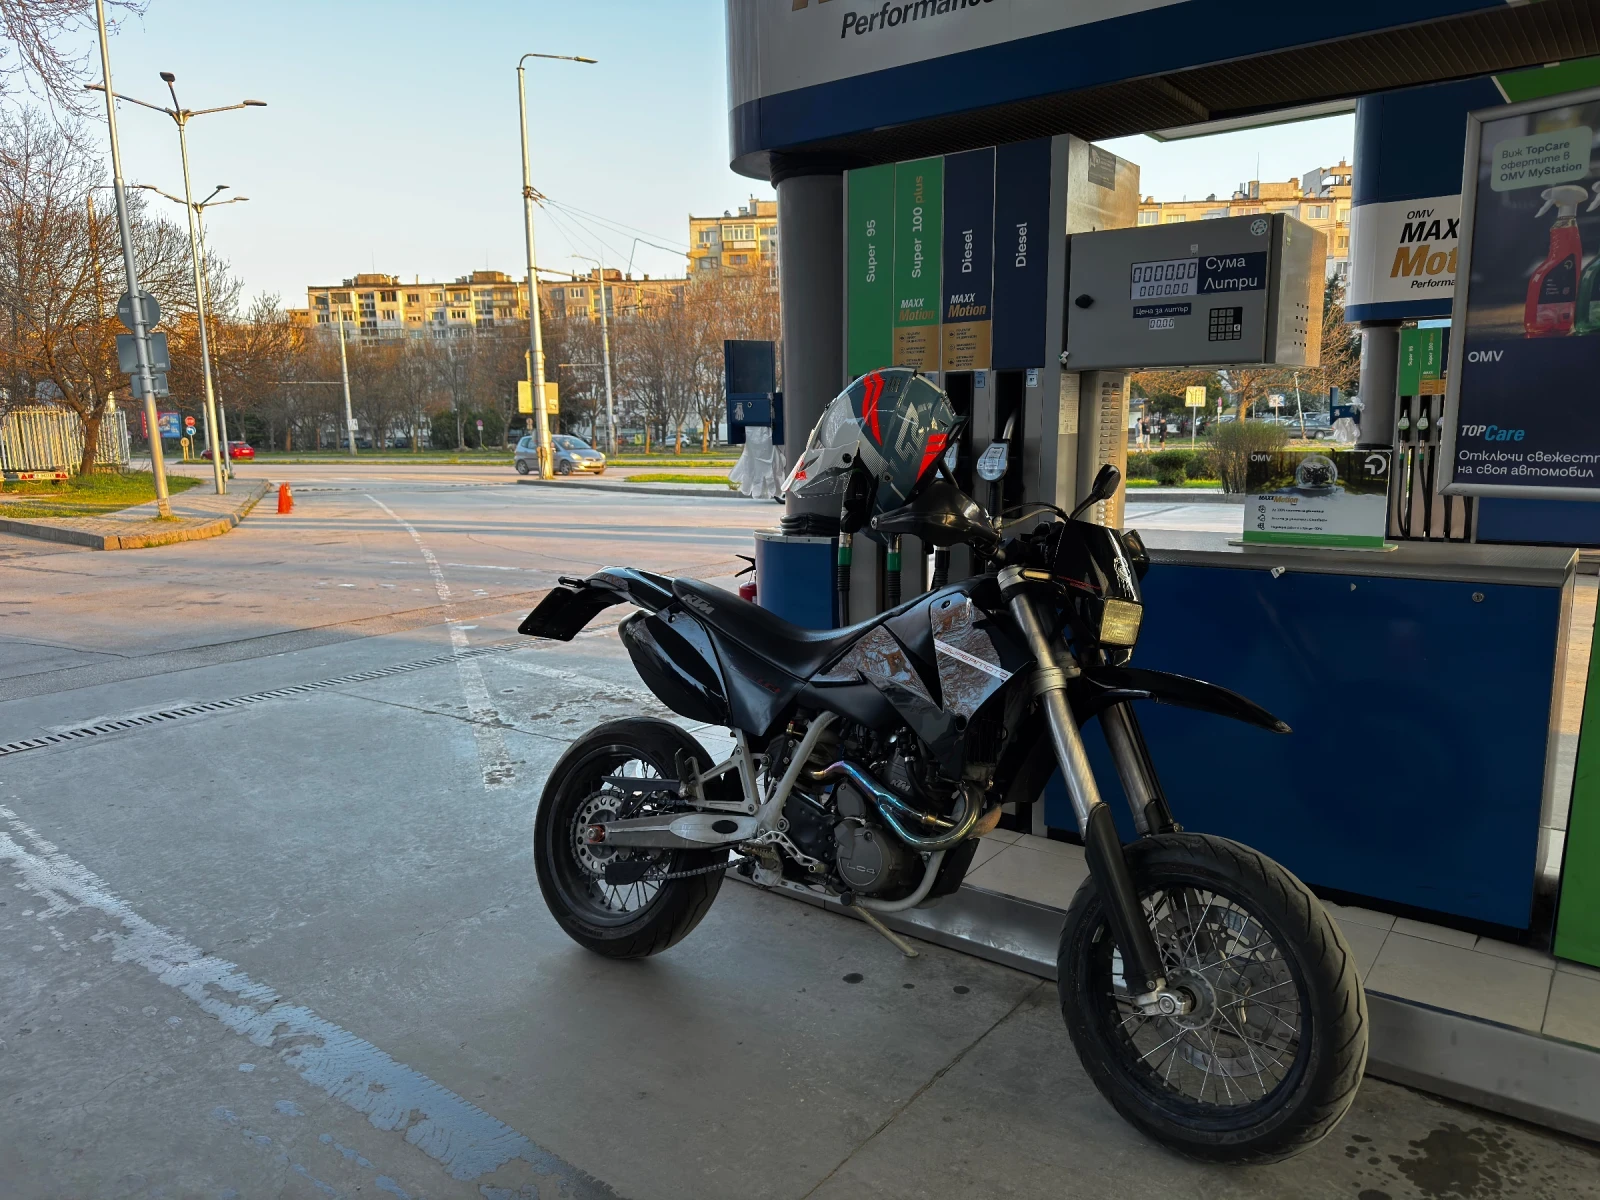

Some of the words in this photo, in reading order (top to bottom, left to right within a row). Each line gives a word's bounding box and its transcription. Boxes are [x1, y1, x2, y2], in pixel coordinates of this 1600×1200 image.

[841, 0, 995, 39] Performan
[1502, 147, 1523, 159] Виж
[1525, 141, 1571, 155] TopCare
[1500, 154, 1560, 171] офертите
[1500, 171, 1526, 181] OMV
[1528, 163, 1582, 178] MyStation
[913, 175, 926, 204] plus
[912, 206, 923, 232] 100
[1406, 209, 1435, 220] OMV
[866, 219, 876, 237] 95
[961, 228, 973, 273] Diesel
[1015, 222, 1028, 268] Diesel
[866, 243, 878, 283] Super
[912, 238, 924, 278] Super
[1205, 256, 1246, 273] Сума
[1203, 276, 1258, 291] Литри
[900, 297, 925, 309] MAXX
[950, 292, 976, 304] MAXX
[898, 308, 936, 322] Motion
[947, 303, 987, 318] Motion
[1135, 307, 1154, 316] Цена
[1164, 305, 1189, 315] литър
[1467, 350, 1504, 363] OMV
[1250, 454, 1272, 462] OMV
[1458, 449, 1523, 462] Отключи
[1457, 465, 1473, 474] на
[1476, 463, 1508, 475] своя
[1510, 464, 1594, 477] автомобил
[681, 593, 715, 615] KTM
[889, 779, 911, 792] KTM
[846, 862, 876, 875] LC4
